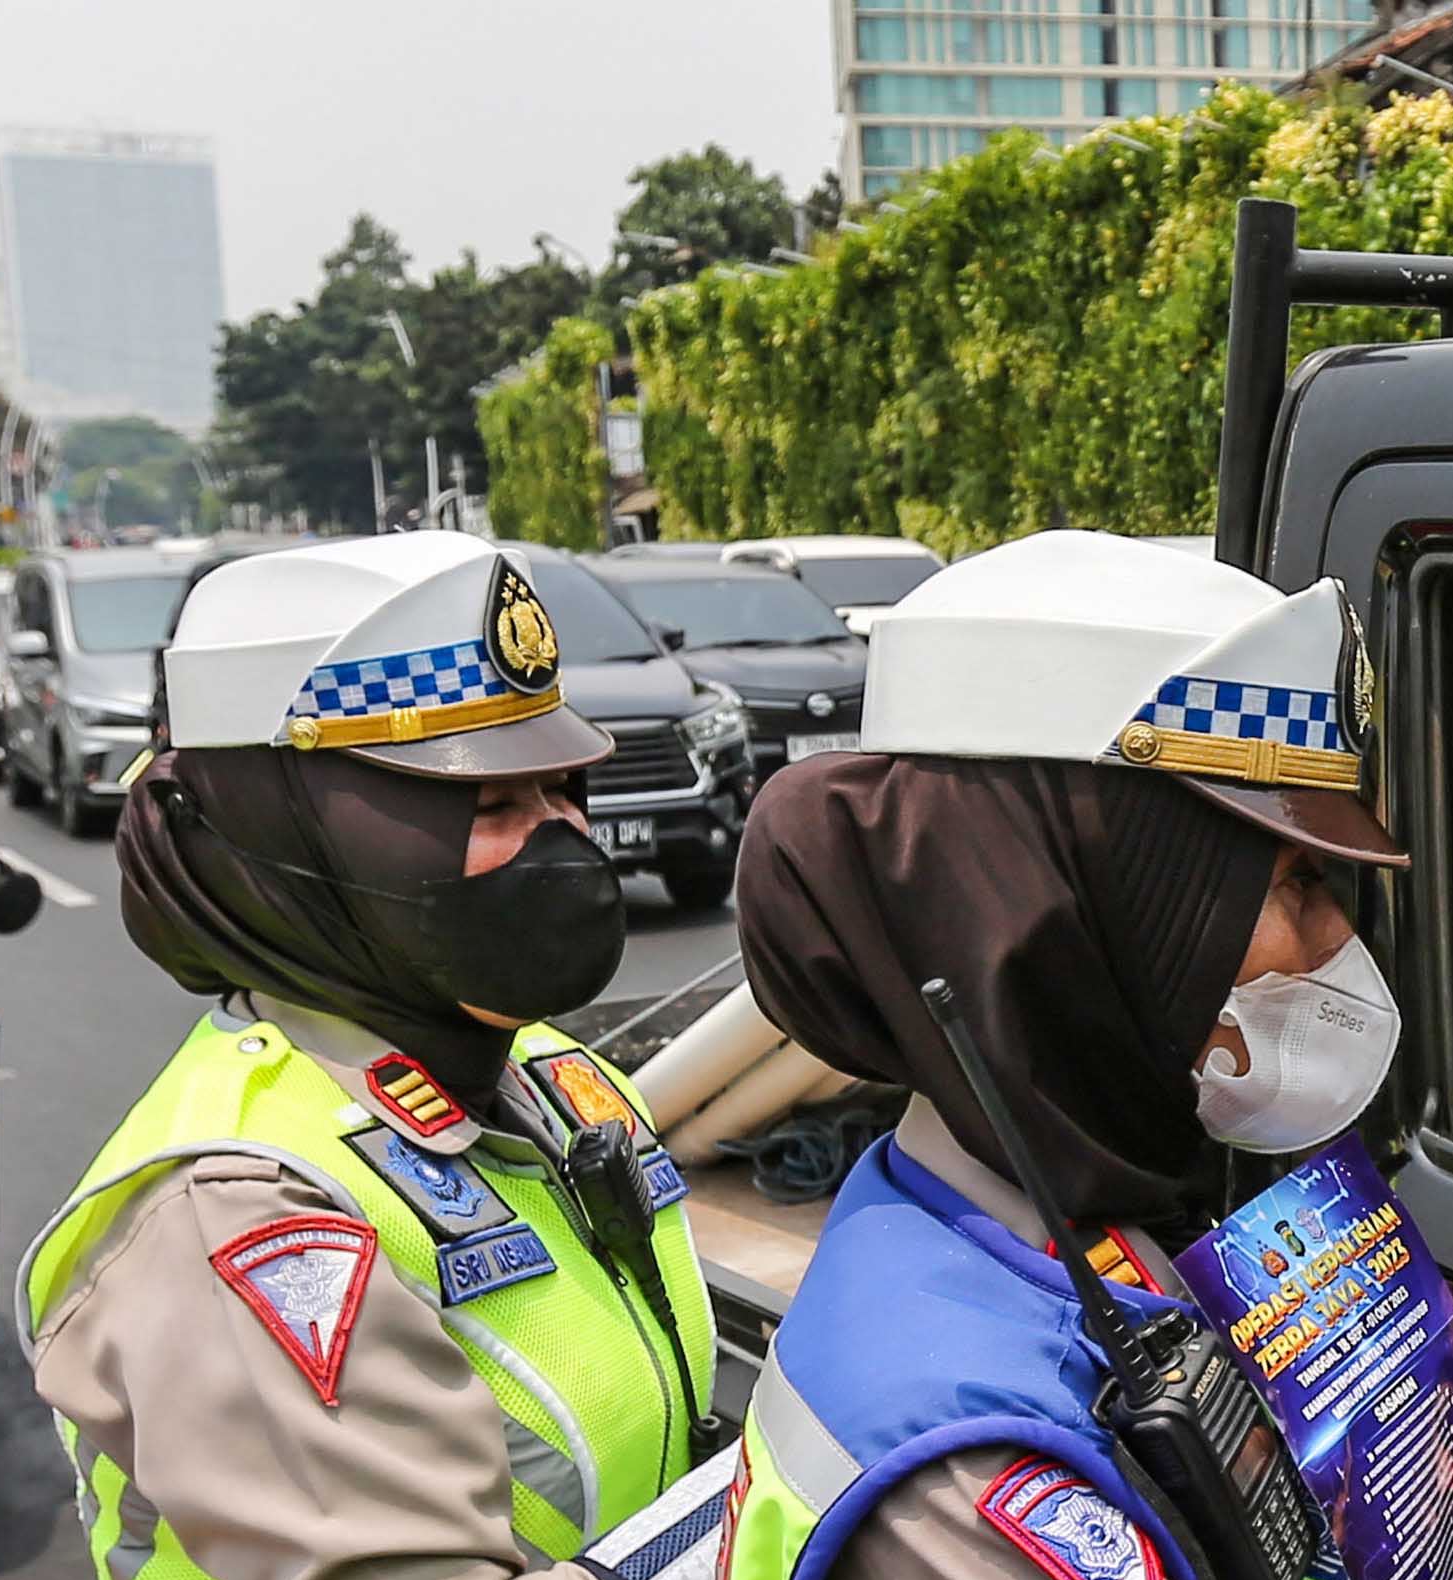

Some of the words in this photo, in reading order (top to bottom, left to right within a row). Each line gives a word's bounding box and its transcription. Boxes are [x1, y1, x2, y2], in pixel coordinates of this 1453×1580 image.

[276, 1230, 314, 1248] LALU
[453, 1250, 492, 1288] SRI
[1229, 1276, 1309, 1353] OPERASI
[1300, 1202, 1402, 1293] KEPOLISIAN
[1253, 1315, 1326, 1381] ZEBRA
[1313, 1278, 1368, 1328] JAYA
[1365, 1236, 1412, 1285] 2023
[1295, 1346, 1343, 1388] TANGGAL
[1336, 1338, 1351, 1353] 18
[1346, 1322, 1368, 1347] SEPT
[1388, 1285, 1410, 1308] 2023
[1379, 1325, 1401, 1349] YANG
[1331, 1386, 1365, 1420] MENUJU
[1359, 1360, 1392, 1393] PEMILU
[1385, 1341, 1413, 1369] DAMAI
[1406, 1327, 1427, 1350] 2024
[1373, 1375, 1419, 1422] SASARAN
[1004, 1471, 1048, 1517] POLISI
